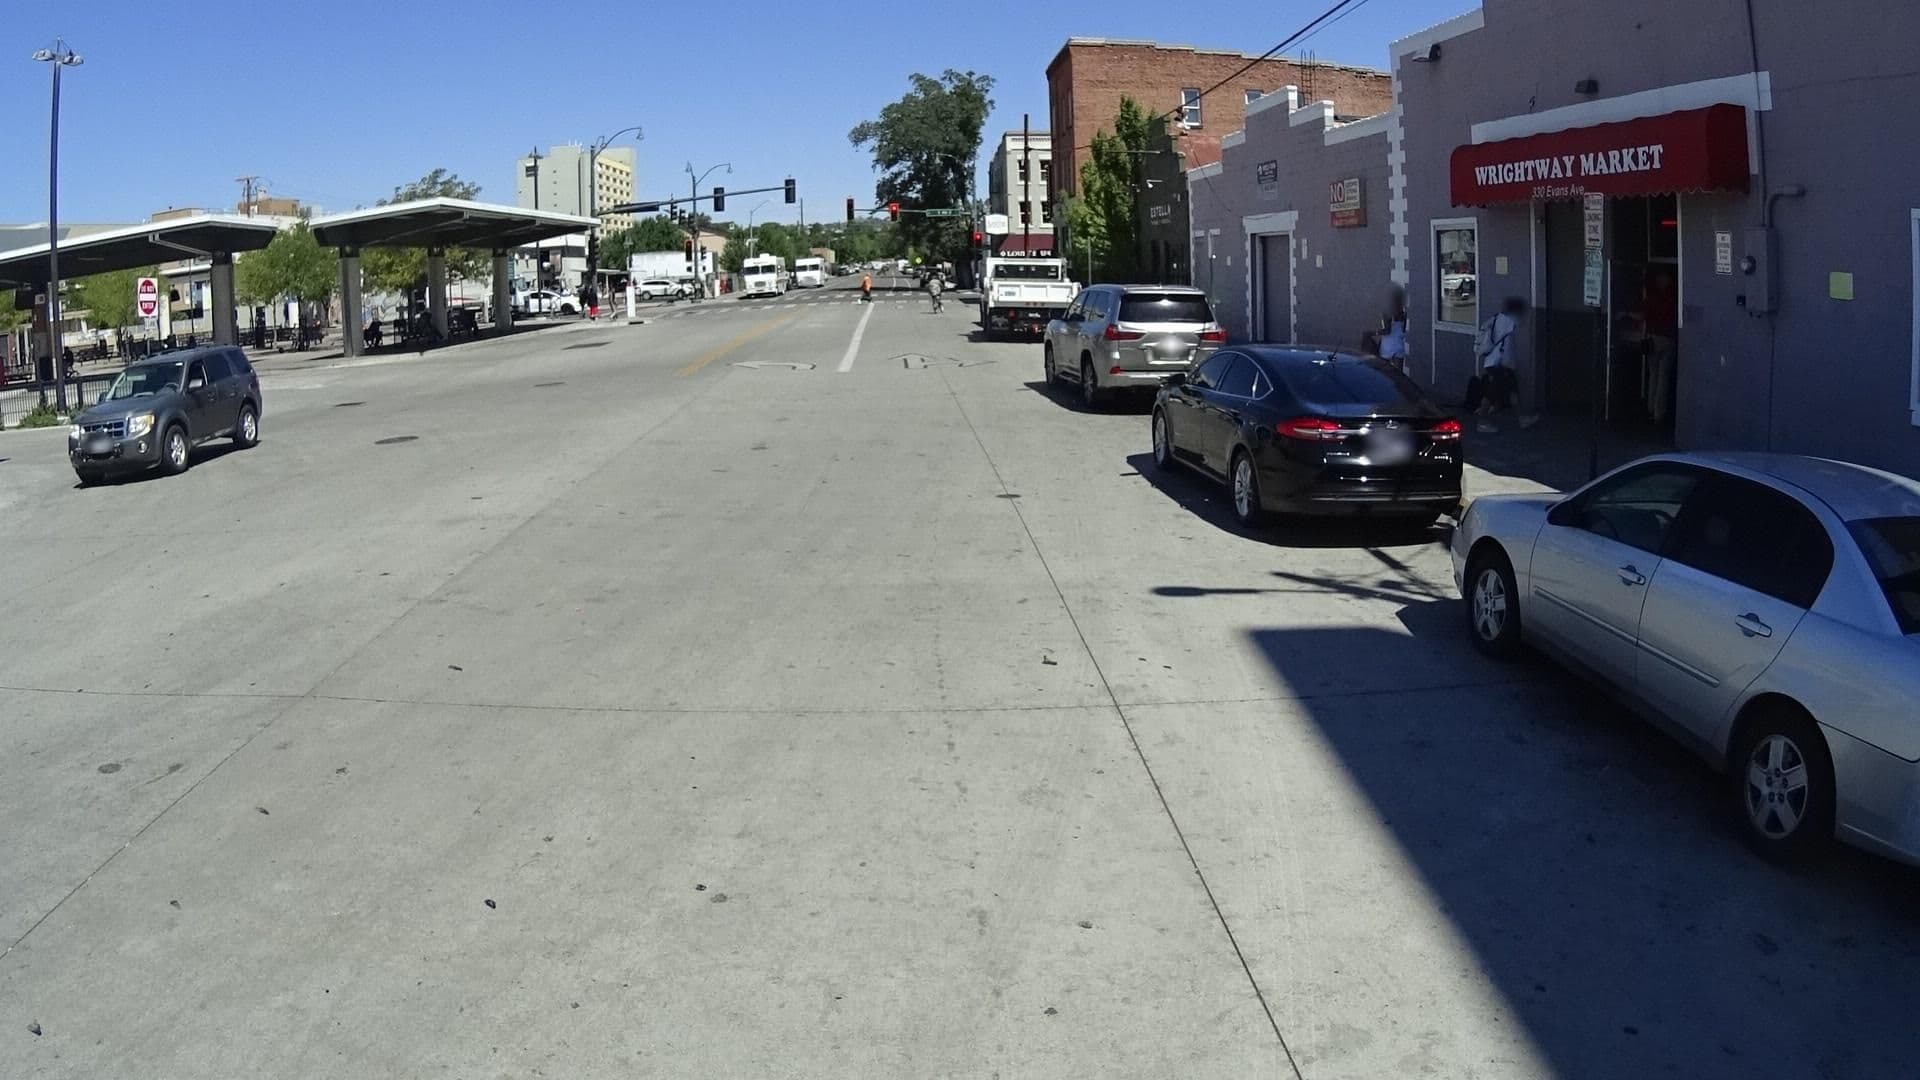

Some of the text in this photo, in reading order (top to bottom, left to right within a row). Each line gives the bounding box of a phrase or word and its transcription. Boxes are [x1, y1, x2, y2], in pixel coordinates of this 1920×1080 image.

[1475, 144, 1664, 186] WRIGHTWAY MARKET
[1330, 182, 1344, 202] NO
[1531, 183, 1585, 199] 330 Evans Ave
[1150, 205, 1171, 217] ESTELLA
